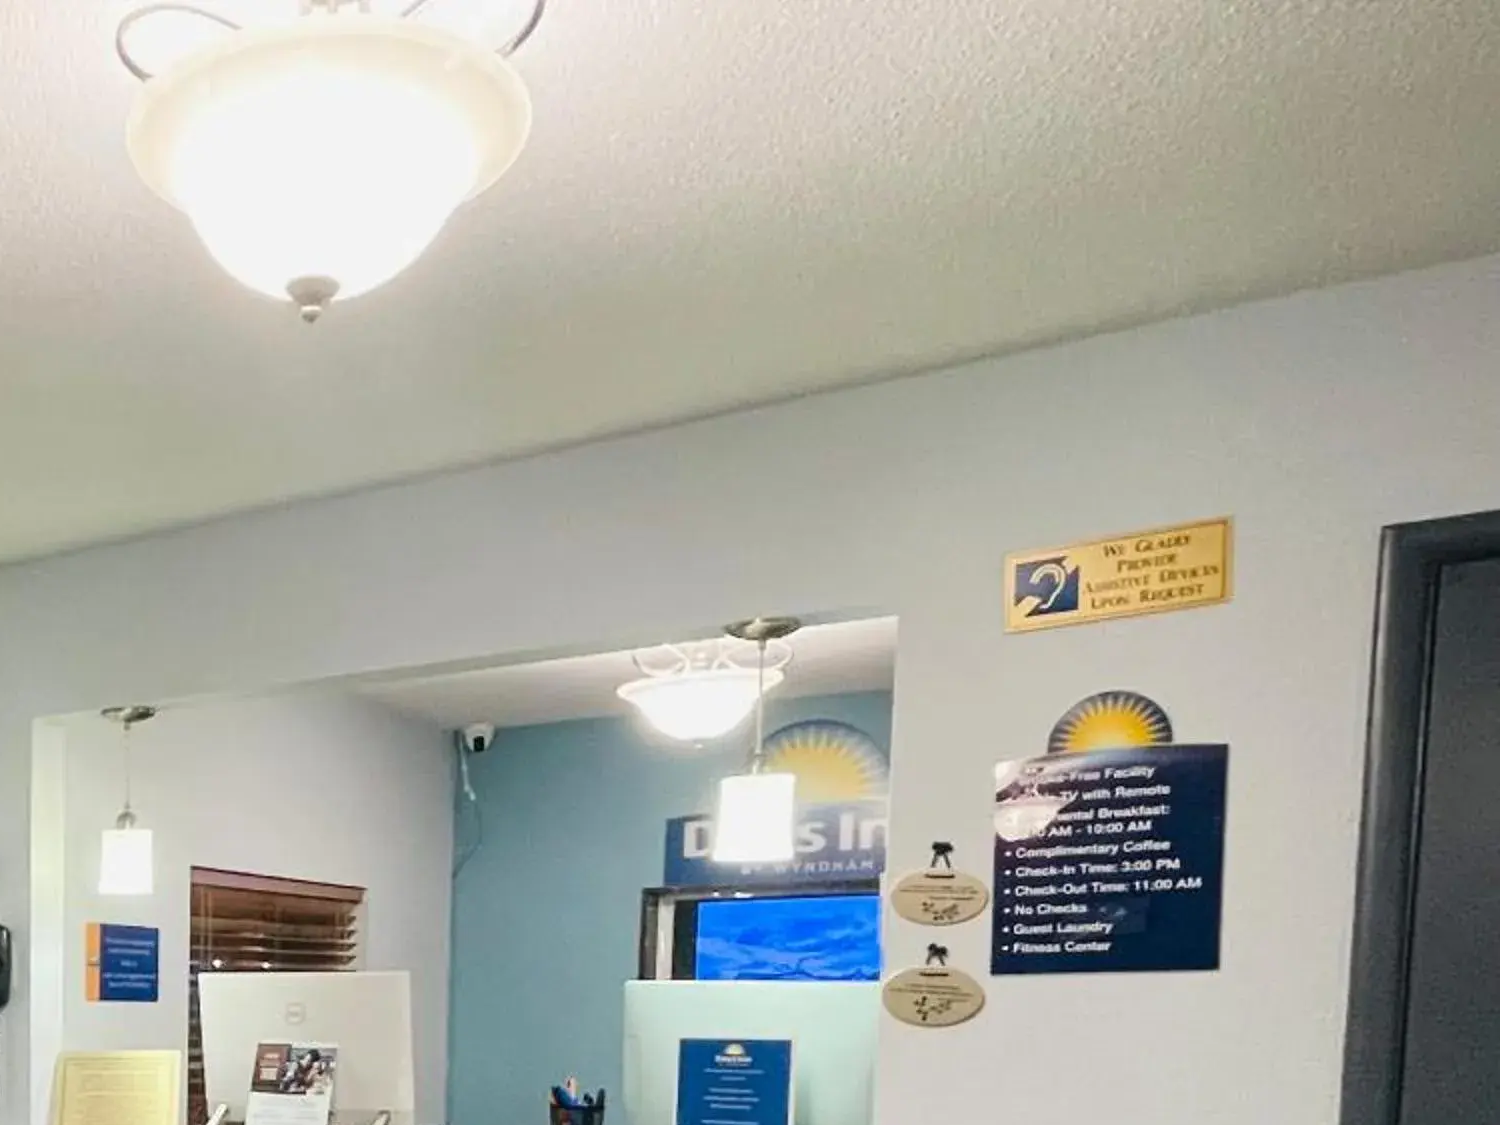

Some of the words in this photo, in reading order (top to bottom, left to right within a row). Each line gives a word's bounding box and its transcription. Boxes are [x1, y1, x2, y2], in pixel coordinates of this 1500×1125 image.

[1104, 766, 1156, 780] Facility
[1082, 788, 1111, 800] with
[1115, 785, 1171, 797] Remote
[1097, 804, 1171, 819] Breakfast:
[1049, 825, 1073, 837] AM
[1086, 823, 1123, 834] 10:00
[1127, 821, 1152, 831] AM
[1015, 843, 1119, 859] Complimentary
[1123, 840, 1172, 853] Coffee
[775, 858, 874, 874] WYNDHAM
[1015, 864, 1075, 877] Check-In
[1079, 861, 1118, 874] Time:
[1121, 860, 1151, 872] 3:00
[1155, 858, 1181, 870] PM
[1015, 882, 1087, 897] Check-Out
[1091, 880, 1129, 893] Time:
[1134, 879, 1172, 891] 11:00
[1175, 877, 1203, 890] AM
[1014, 905, 1033, 916] No
[1037, 903, 1088, 915] Checks
[1013, 922, 1053, 935] Guest
[1057, 920, 1115, 935] Laundry
[1013, 942, 1061, 954] Fitness
[1064, 940, 1112, 952] Center
